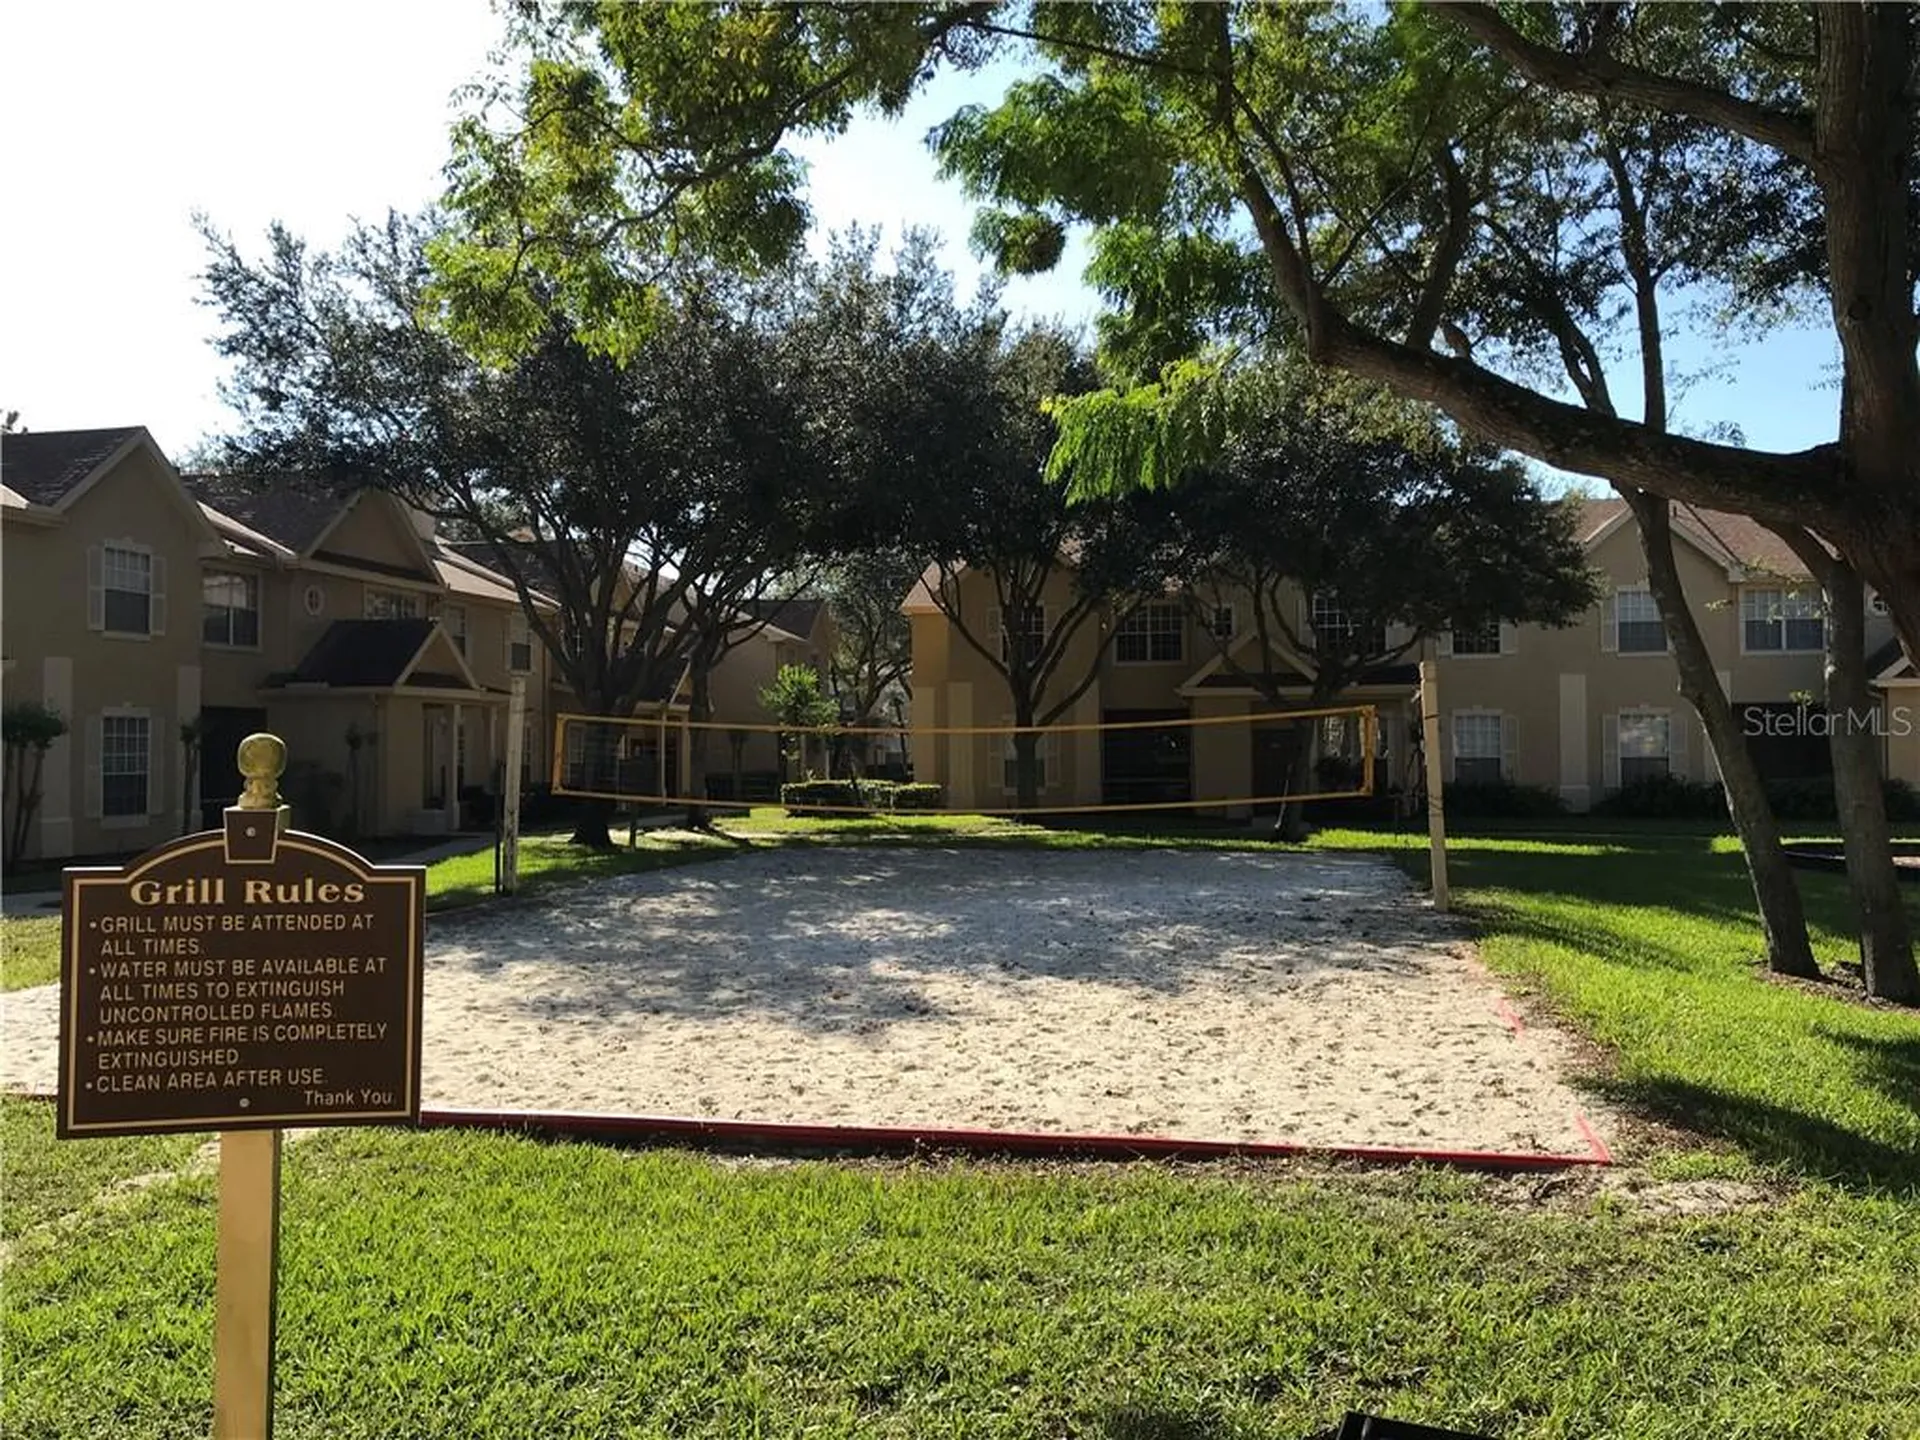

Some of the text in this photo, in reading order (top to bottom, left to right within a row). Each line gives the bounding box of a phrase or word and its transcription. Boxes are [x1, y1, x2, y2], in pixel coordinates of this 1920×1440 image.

[130, 877, 366, 905] Grill Rules
[101, 914, 374, 933] GRILL MUST BE ATTENDED AT
[101, 939, 136, 956] ALL
[101, 957, 387, 979] WATER MUST BE AVAILABLE AT
[100, 980, 345, 1001] ALL TIMES TO EXTINGUISH
[100, 1004, 255, 1025] UNCONTROLLED
[98, 1022, 388, 1048] MAKE SURE FIRE IS COMPLETELY
[97, 1074, 161, 1093] CLEAN
[167, 1072, 217, 1090] AREA
[222, 1070, 282, 1087] AFTER
[304, 1090, 355, 1107] Thank
